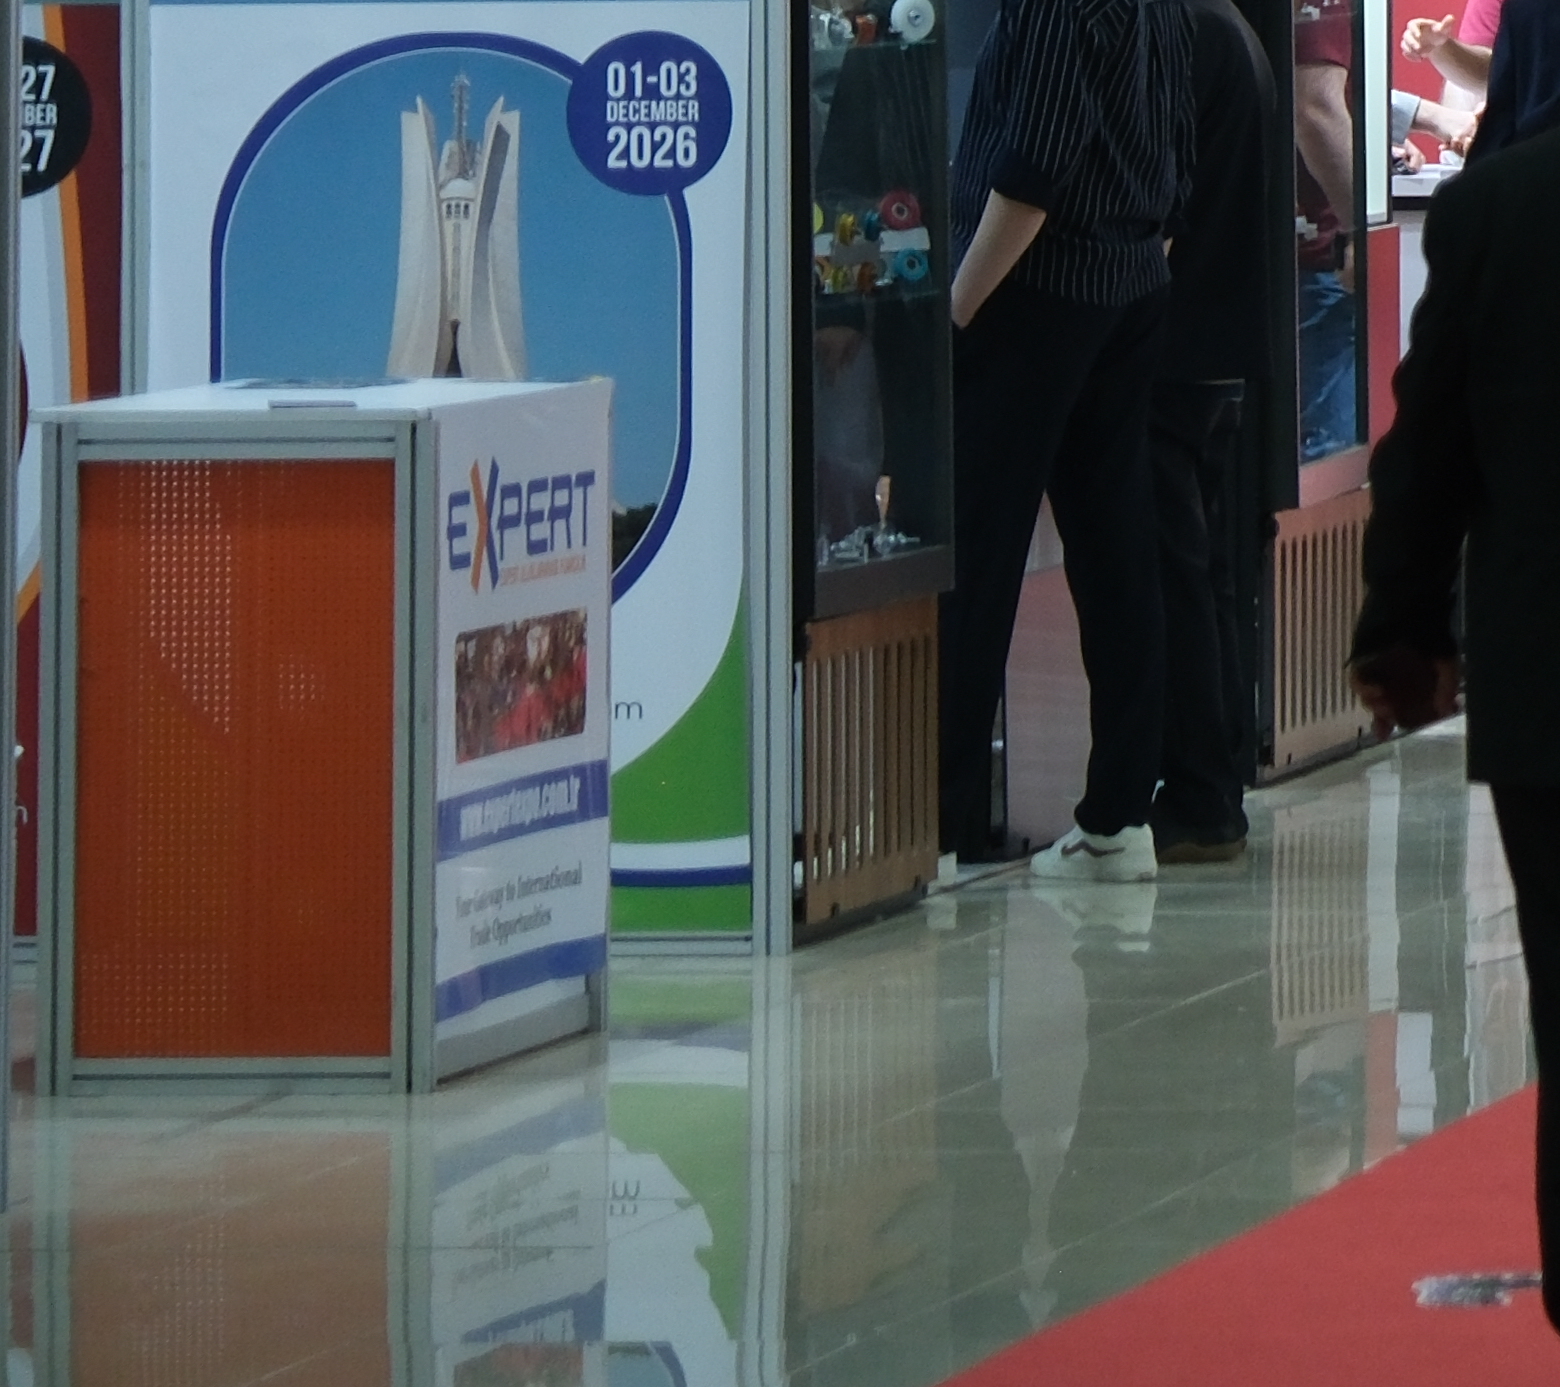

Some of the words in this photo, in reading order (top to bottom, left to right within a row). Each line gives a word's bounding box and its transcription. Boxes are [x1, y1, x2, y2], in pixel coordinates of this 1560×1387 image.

[606, 61, 699, 98] 01-03
[605, 99, 700, 123] DECEMBER
[605, 126, 699, 170] 2026
[446, 455, 596, 596] EXPERT
